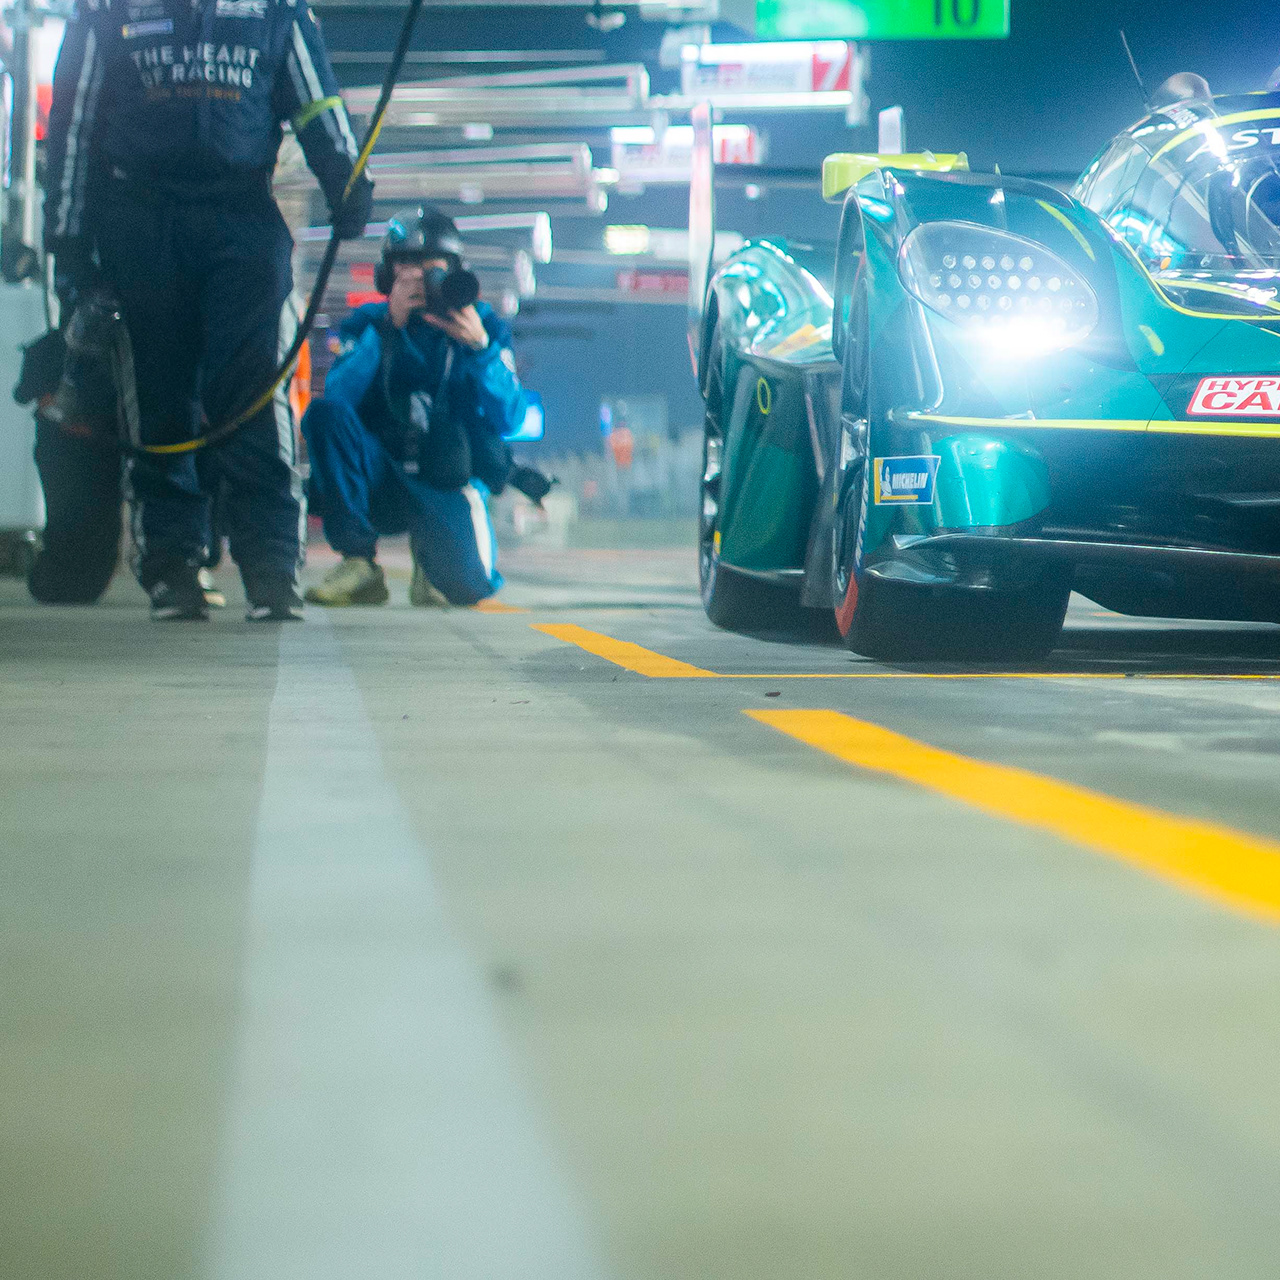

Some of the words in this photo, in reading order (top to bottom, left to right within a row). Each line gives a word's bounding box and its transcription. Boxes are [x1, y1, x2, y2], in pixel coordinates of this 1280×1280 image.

[130, 46, 174, 68] THE
[173, 63, 252, 89] RACING
[892, 472, 928, 489] MICHELIN
